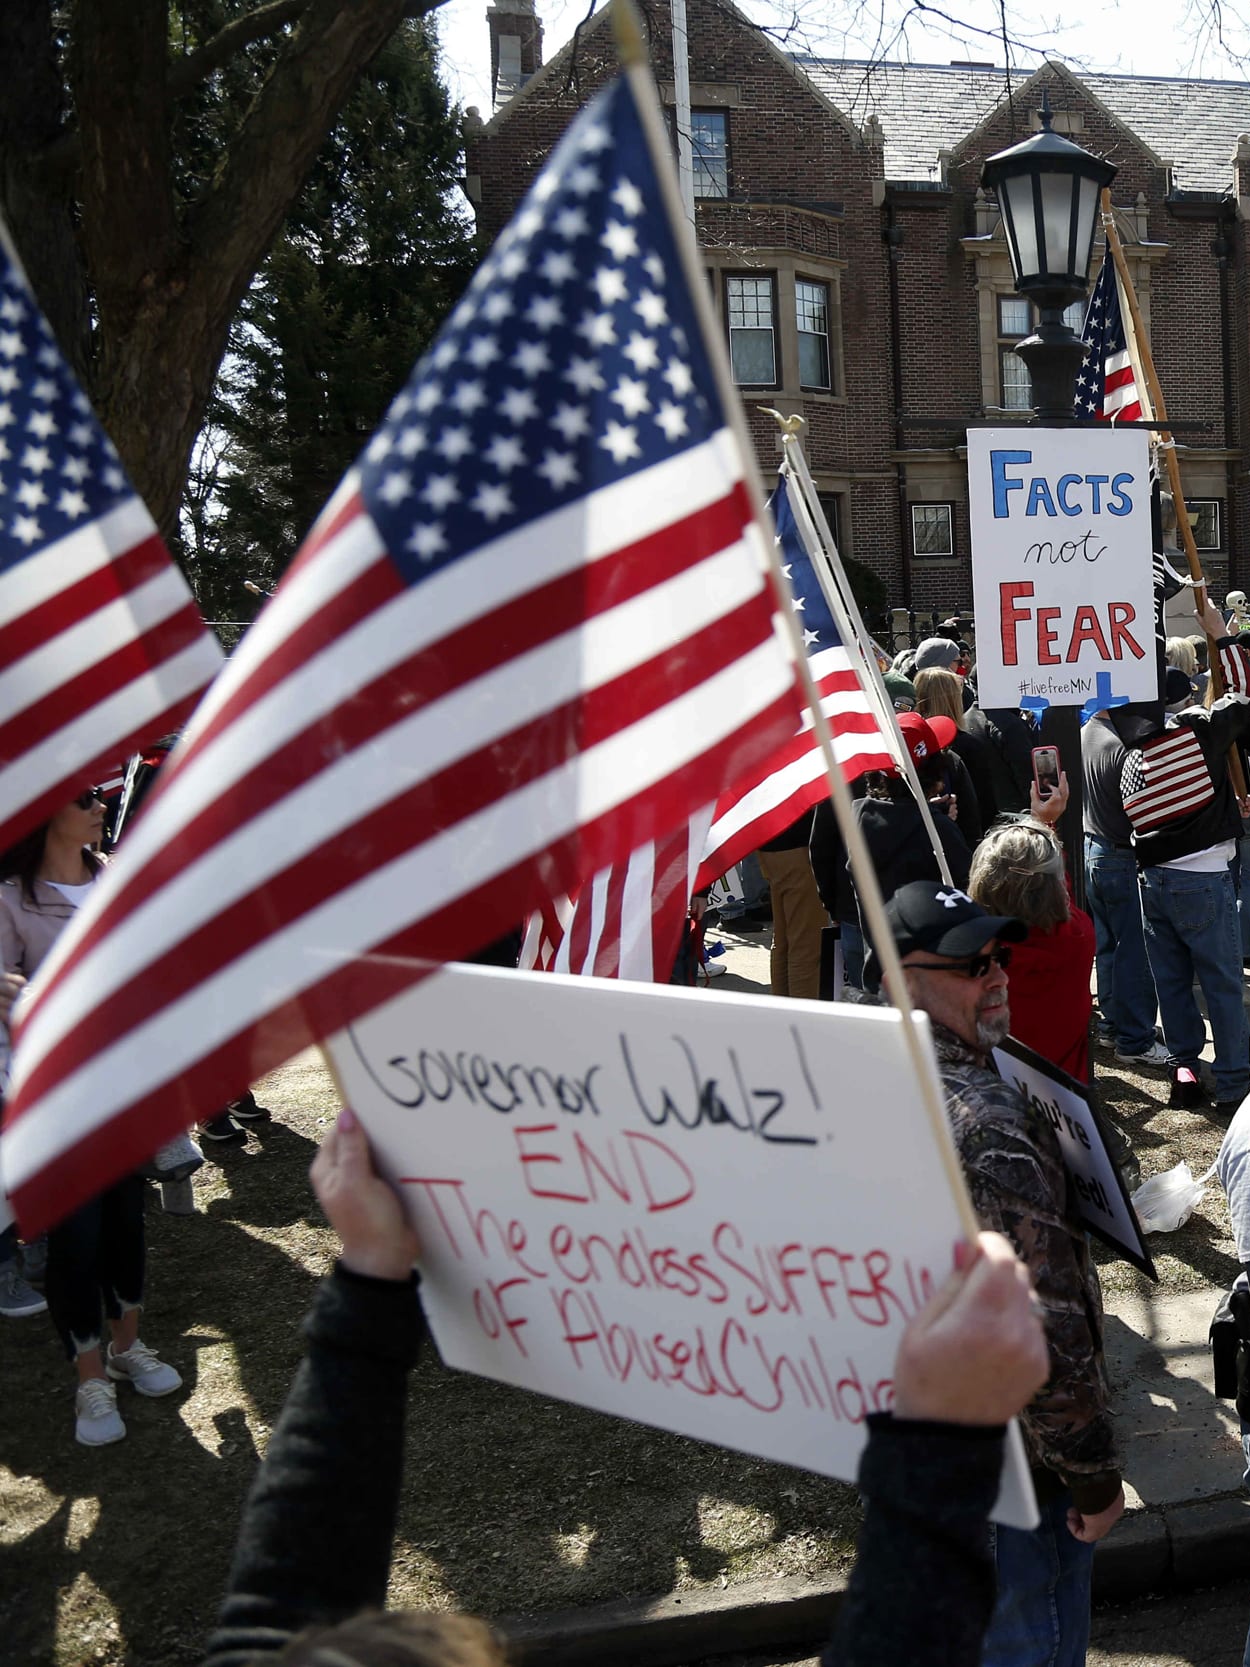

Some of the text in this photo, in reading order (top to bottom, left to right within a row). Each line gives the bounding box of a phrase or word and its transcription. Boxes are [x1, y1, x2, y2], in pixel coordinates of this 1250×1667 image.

[990, 450, 1134, 518] FACTS
[1024, 530, 1108, 563] not
[1000, 581, 1147, 666] FEAR
[1018, 676, 1092, 695] #livefreeMN
[346, 1024, 835, 1145] Governor Walz!
[513, 1124, 695, 1212] END
[400, 1178, 548, 1277] The
[549, 1224, 728, 1303] endless
